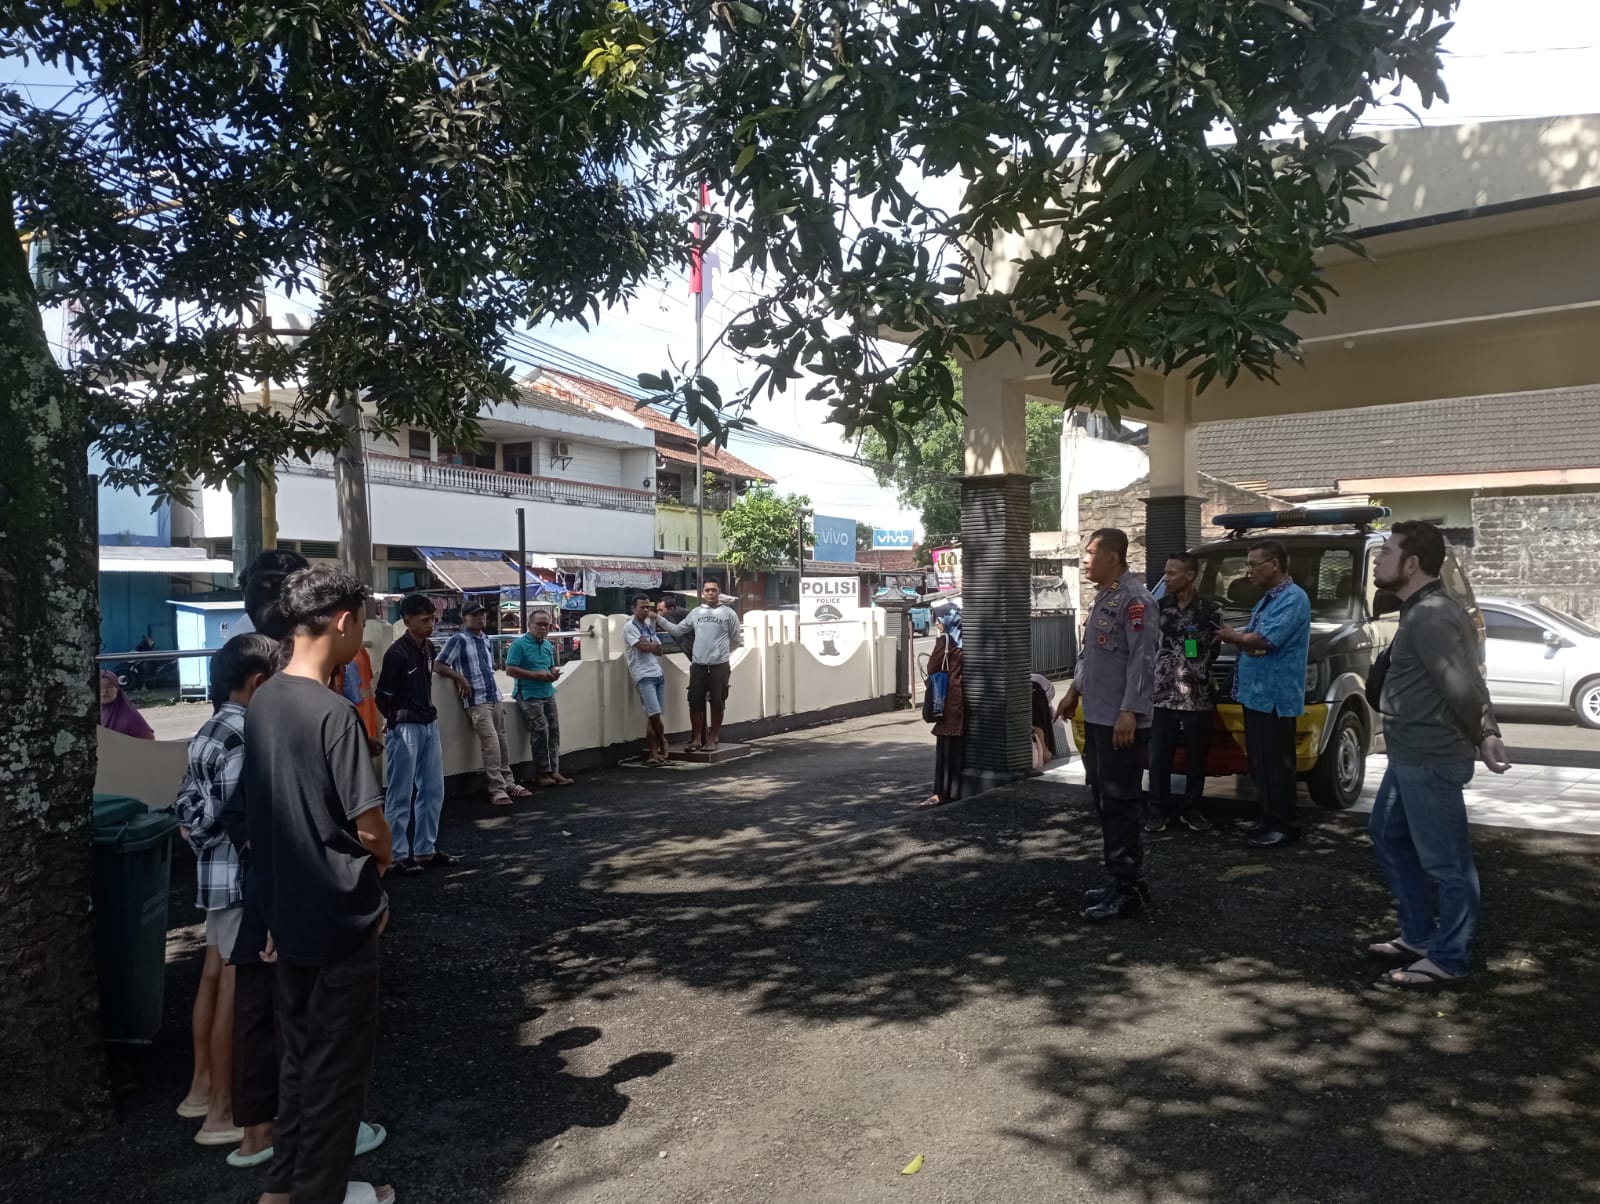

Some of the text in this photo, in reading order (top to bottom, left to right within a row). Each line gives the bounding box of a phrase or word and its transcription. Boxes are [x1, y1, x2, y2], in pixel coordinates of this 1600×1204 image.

[821, 528, 849, 546] vivo
[877, 533, 909, 543] vivo
[801, 581, 857, 595] POLISI
